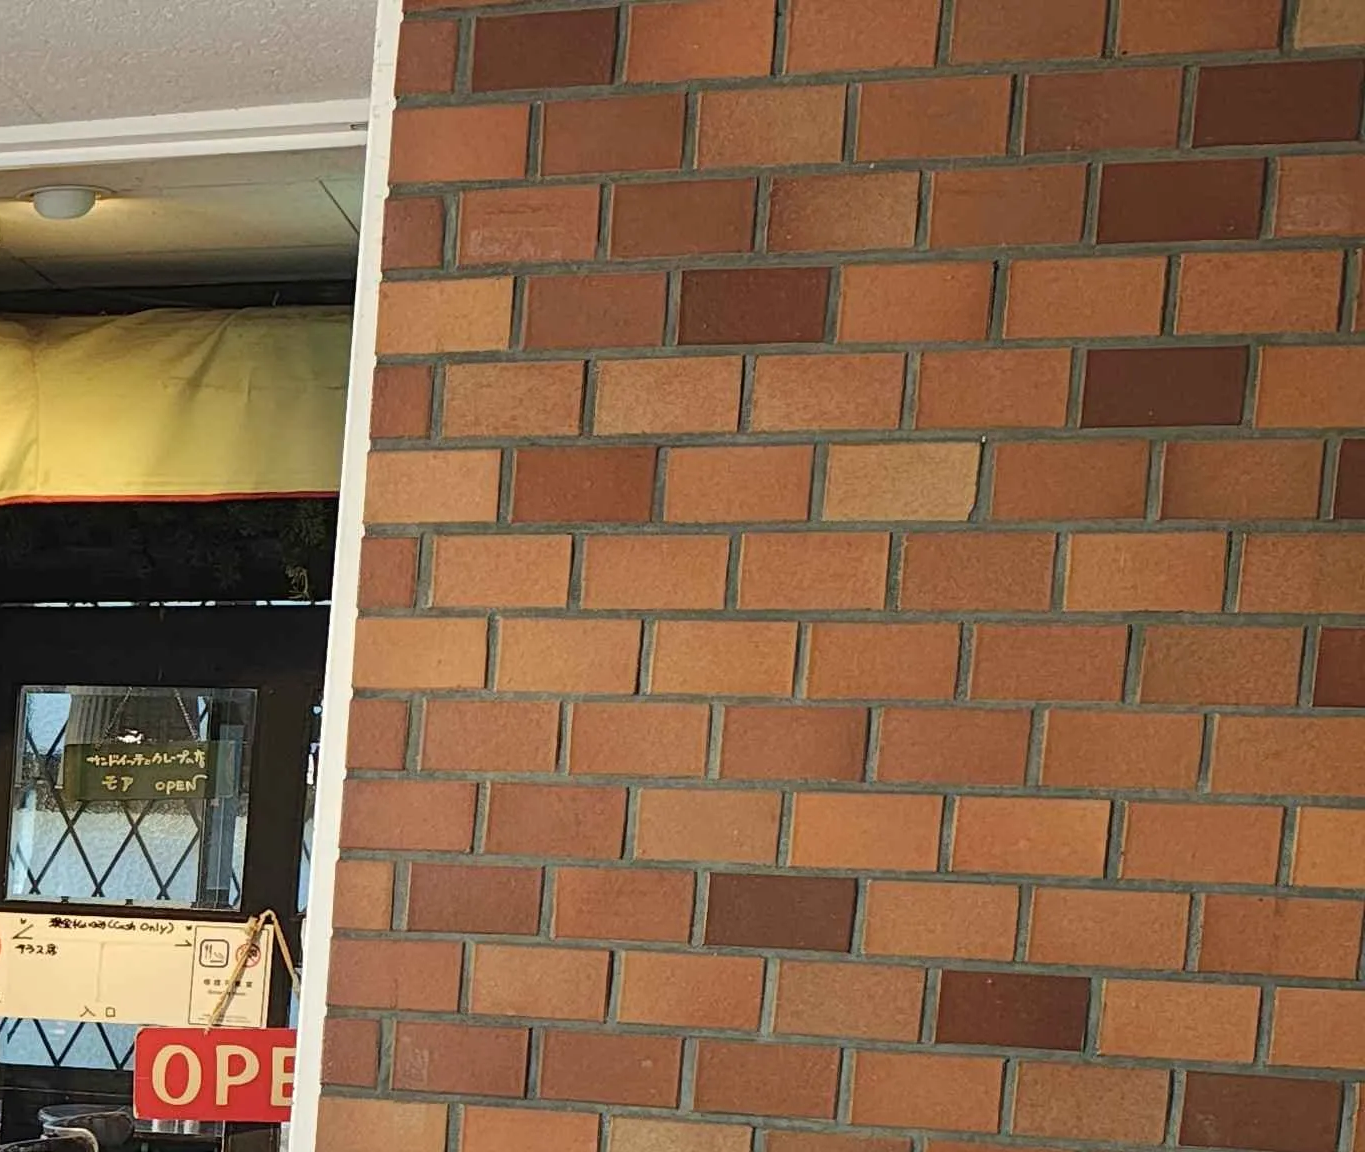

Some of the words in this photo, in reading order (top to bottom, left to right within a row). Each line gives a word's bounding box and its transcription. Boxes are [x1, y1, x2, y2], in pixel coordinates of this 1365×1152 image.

[102, 775, 134, 792] モア
[155, 774, 208, 795] OPEN
[152, 1044, 297, 1107] OPE
